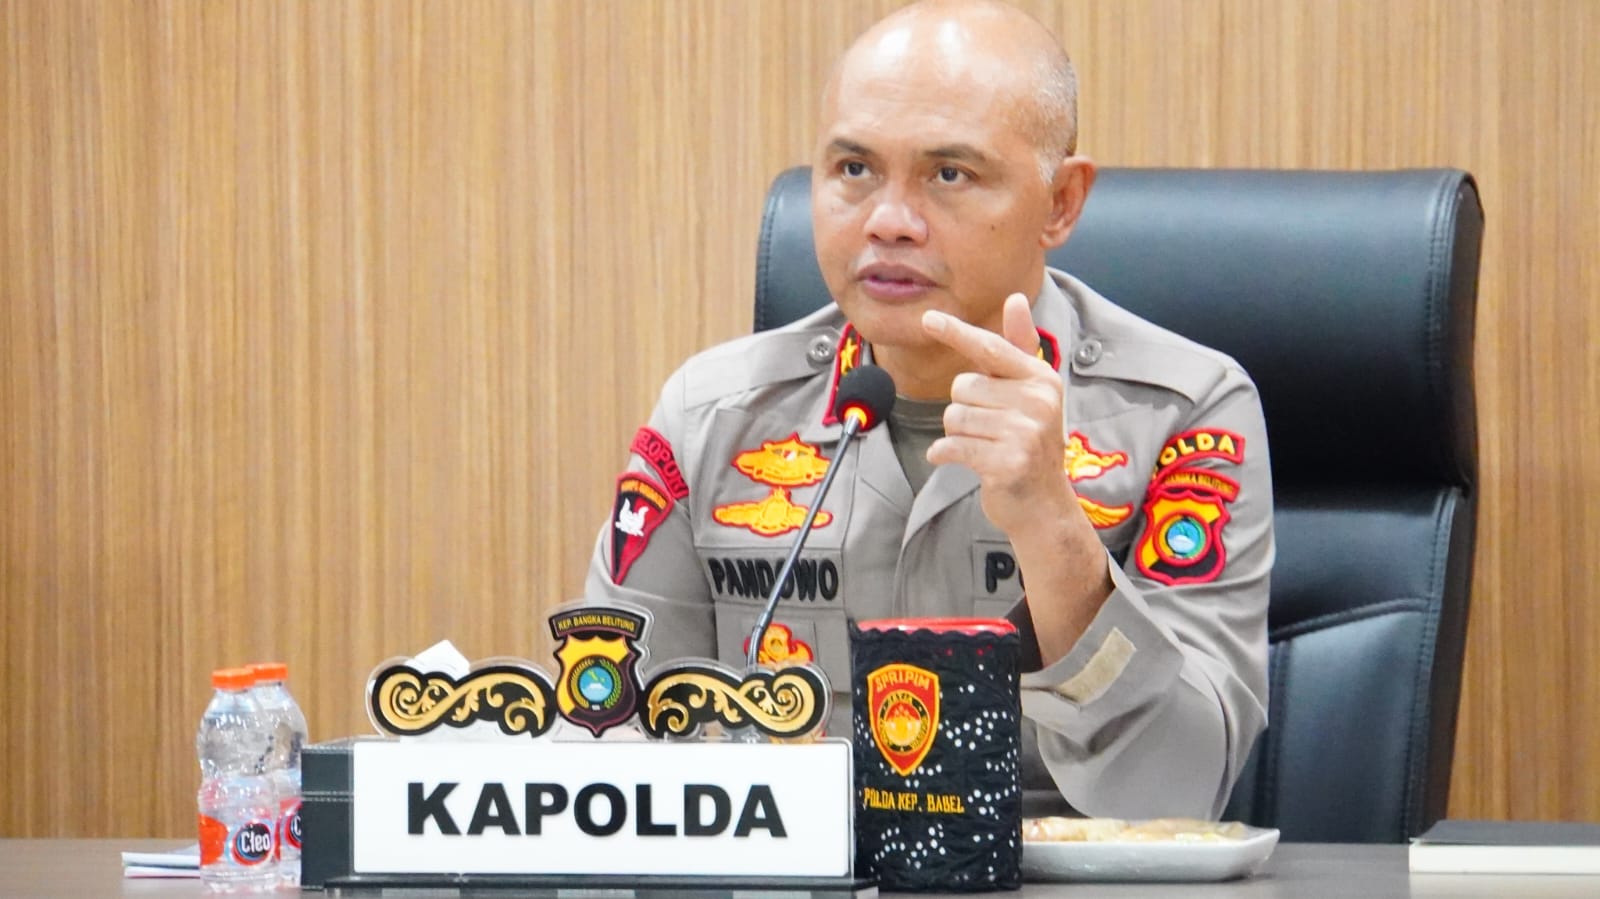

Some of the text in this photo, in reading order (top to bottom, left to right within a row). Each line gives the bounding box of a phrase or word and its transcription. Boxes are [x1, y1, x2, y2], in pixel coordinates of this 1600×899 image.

[707, 557, 839, 602] PANDOWO
[875, 669, 930, 693] SPRIPIM
[406, 781, 789, 839] KAPOLDA
[863, 787, 896, 810] POLDA
[926, 793, 965, 814] BABEL
[240, 830, 271, 853] Cleo
